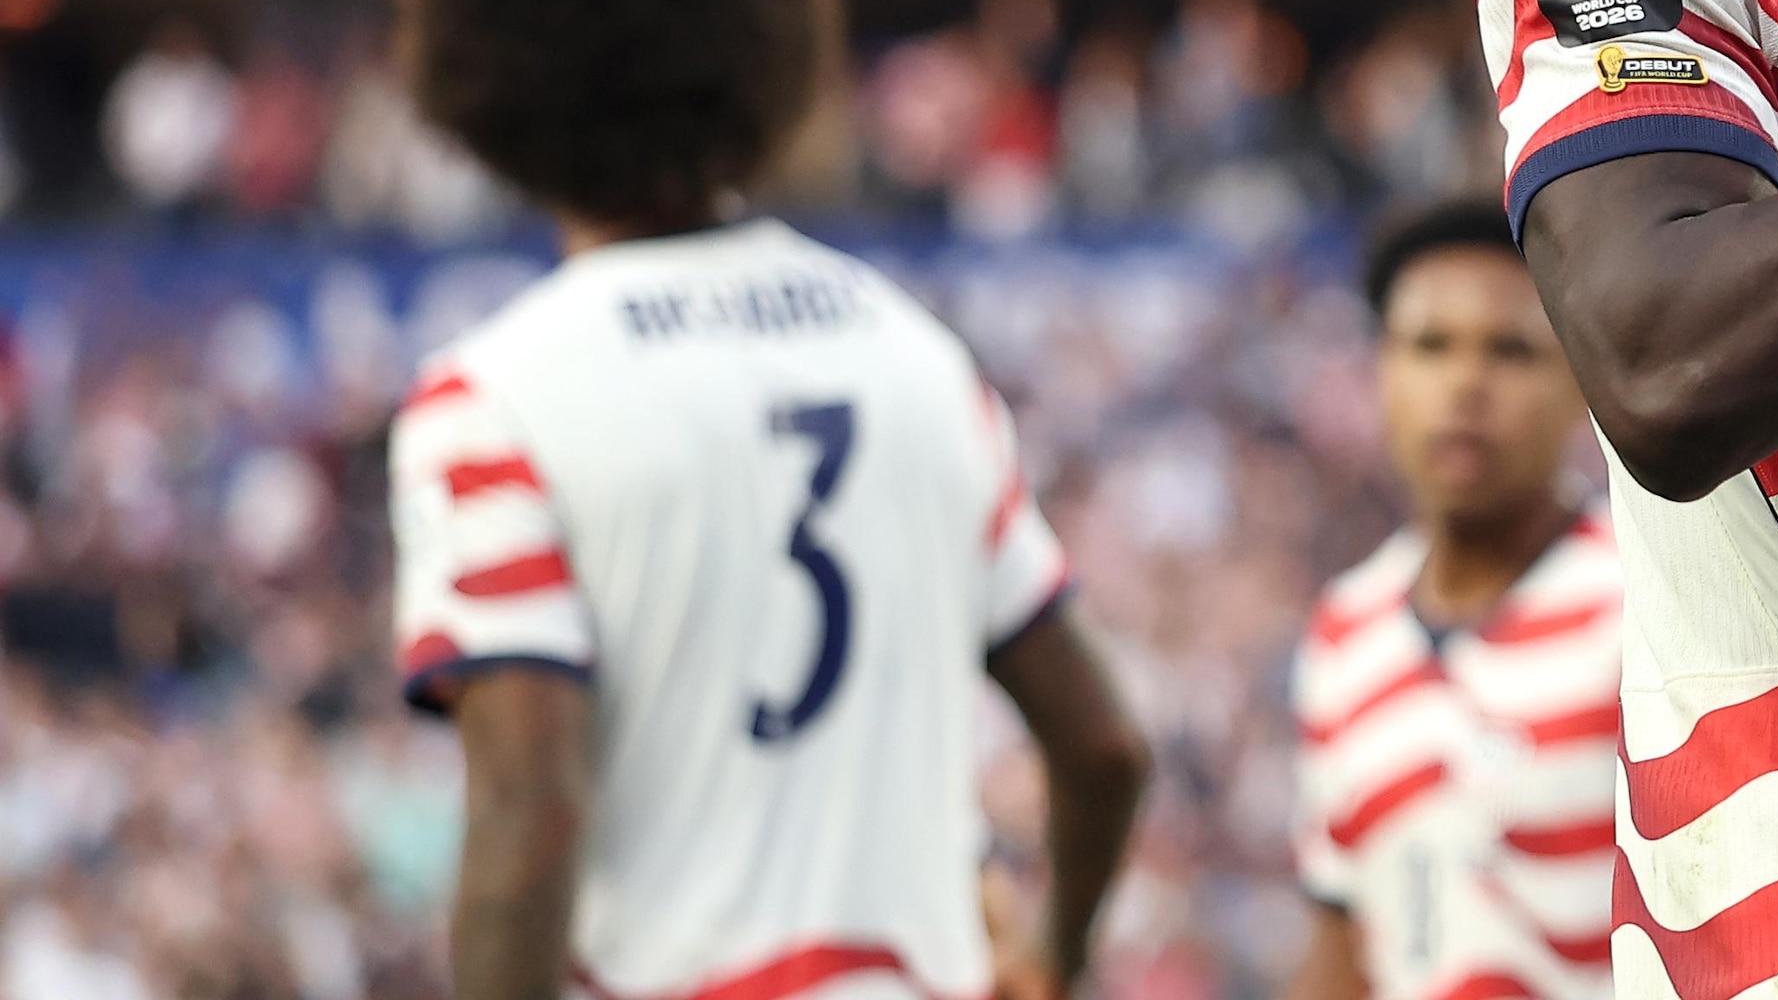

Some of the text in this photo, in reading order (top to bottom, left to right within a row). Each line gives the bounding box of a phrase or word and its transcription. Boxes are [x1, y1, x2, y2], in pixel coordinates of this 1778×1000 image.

[1575, 4, 1645, 31] 2026
[1625, 60, 1696, 72] DEBUT
[752, 402, 854, 742] 3
